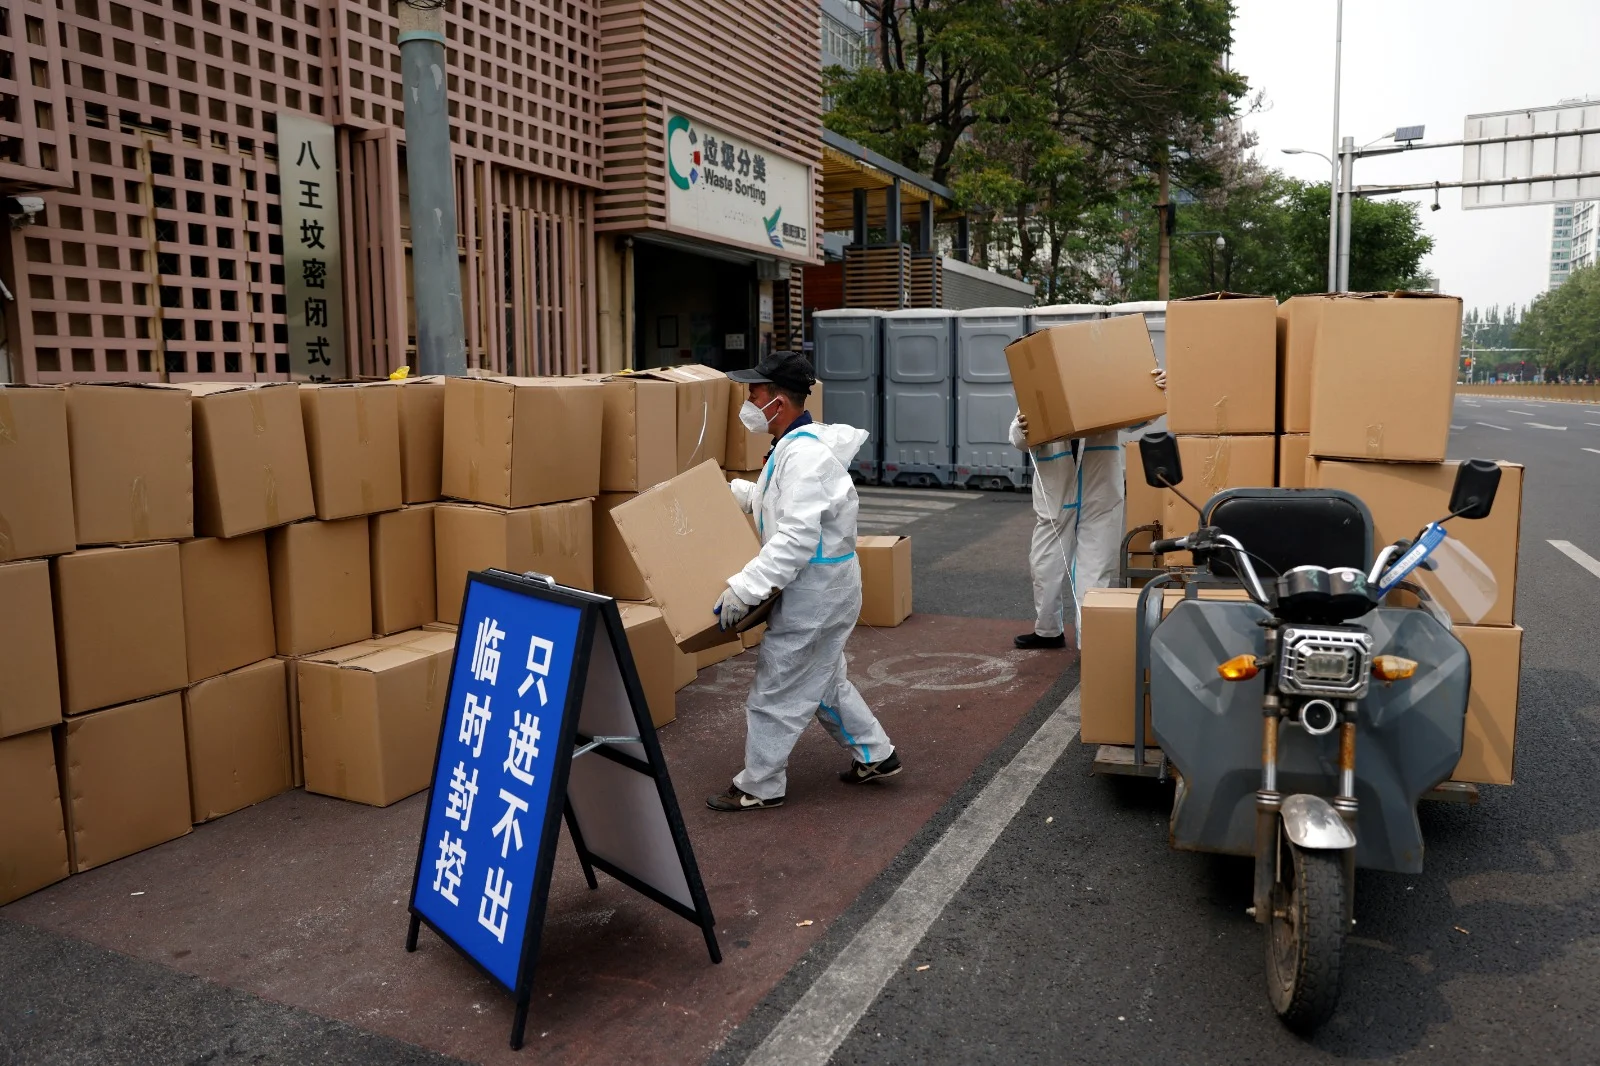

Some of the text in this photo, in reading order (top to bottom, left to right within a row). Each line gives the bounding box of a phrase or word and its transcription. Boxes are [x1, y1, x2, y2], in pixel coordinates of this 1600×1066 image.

[703, 133, 766, 184] 垃圾分类
[704, 167, 766, 206] Waste Sorting
[296, 140, 332, 384] 八王坟密闭式
[1399, 549, 1421, 569] Shield
[432, 616, 506, 907] 临时封控
[477, 635, 554, 944] 只进不出
